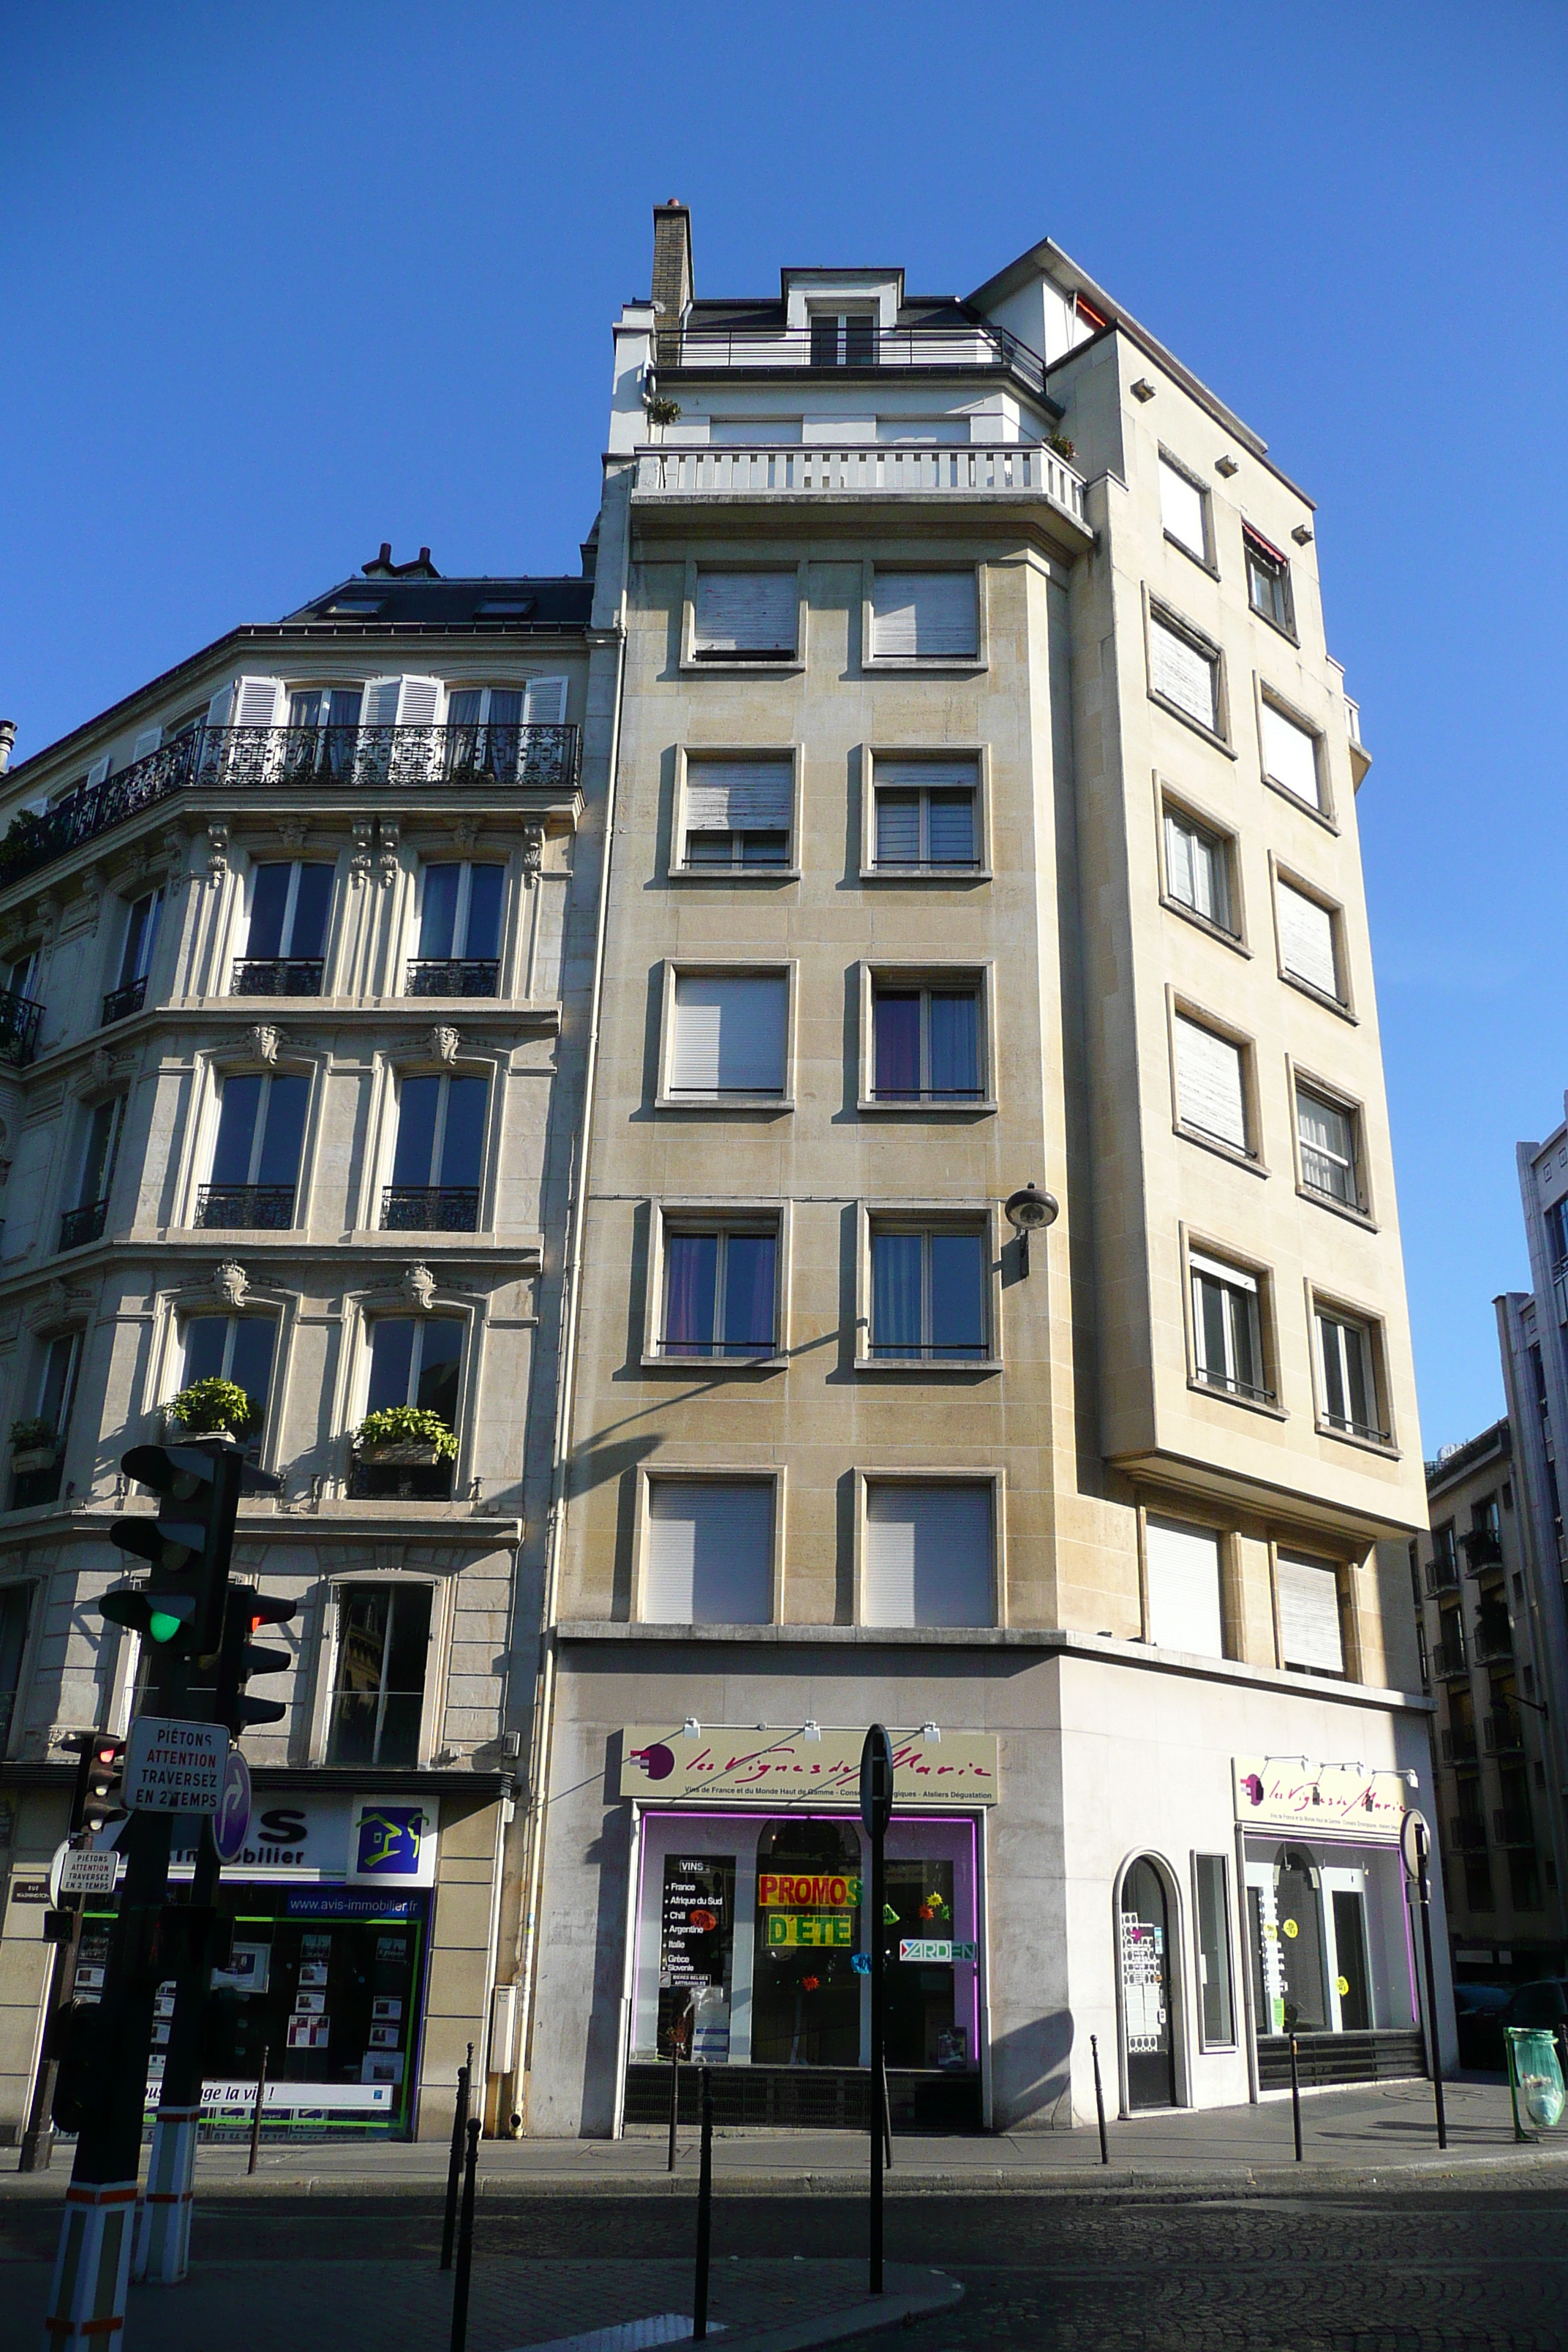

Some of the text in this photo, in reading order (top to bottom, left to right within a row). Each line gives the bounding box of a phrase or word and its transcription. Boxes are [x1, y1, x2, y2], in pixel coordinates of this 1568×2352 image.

[157, 1727, 212, 1746] PIÉTONS
[147, 1749, 216, 1768] ATTENTION
[685, 1746, 992, 1786] les Vignes de Marie
[142, 1768, 217, 1787] TRAVERSEZ
[136, 1789, 217, 1807] EN 2 TEMPS
[951, 1791, 992, 1799] Dégustation
[77, 1853, 108, 1863] PIÉTONS
[71, 1864, 109, 1872] ATTENTION
[682, 1861, 704, 1871] VINS
[69, 1873, 110, 1881] TRAVERSEZ
[86, 1882, 109, 1890] TEMPS
[671, 1882, 696, 1891] France
[760, 1875, 864, 1907] PROMOS
[290, 1899, 418, 1912] www.avis-immobilier.fr
[670, 1896, 723, 1907] Afrique du Sud
[669, 1911, 686, 1920] Chili
[668, 1925, 704, 1935] Argentine
[668, 1940, 685, 1948] Italie
[901, 1941, 977, 1960] YARDEN
[668, 1954, 690, 1963] Grèce
[225, 2086, 239, 2100] la
[244, 2086, 263, 2100] vi
